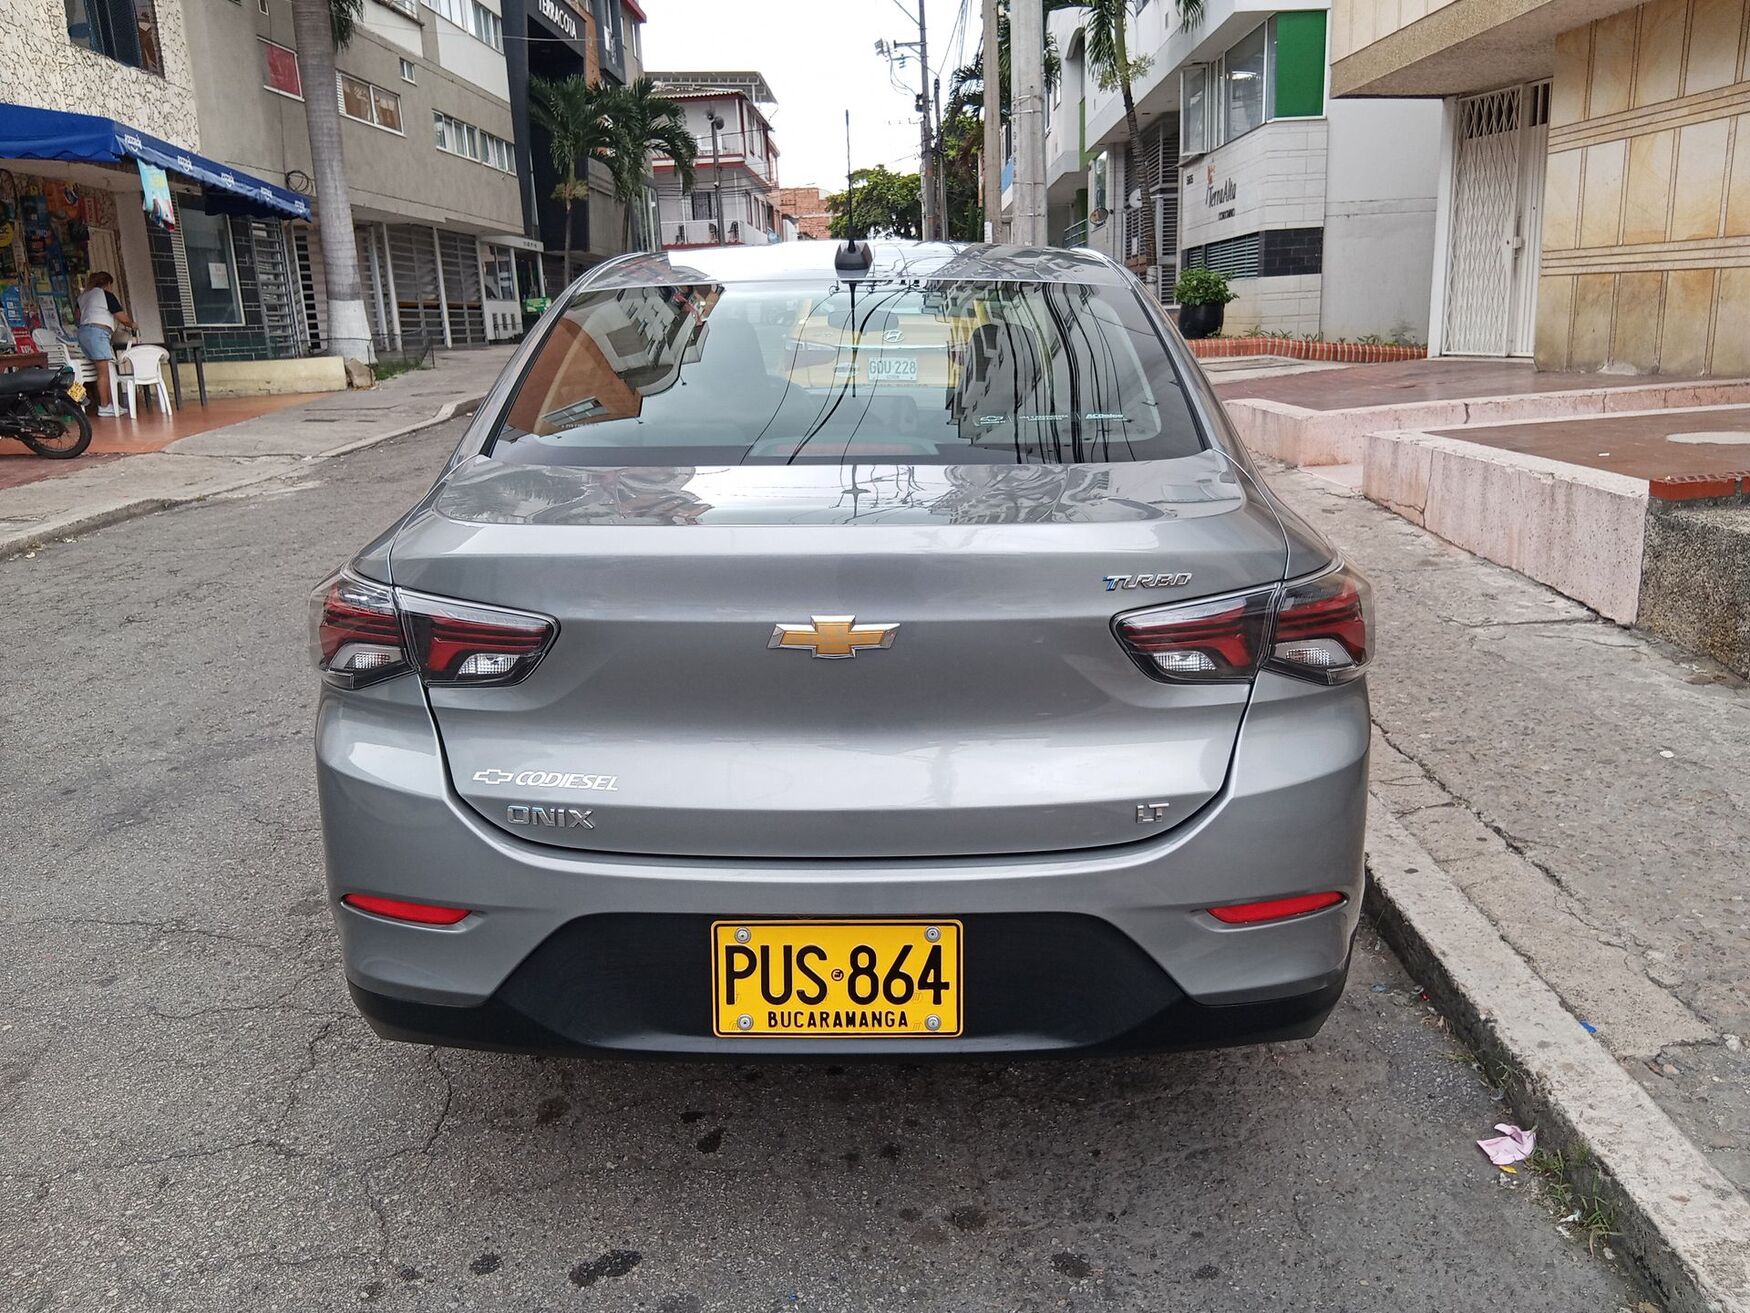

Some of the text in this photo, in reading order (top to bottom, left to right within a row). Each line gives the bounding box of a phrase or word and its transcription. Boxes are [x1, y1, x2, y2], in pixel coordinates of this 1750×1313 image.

[895, 361, 916, 375] 228
[1103, 572, 1192, 591] TURBO
[515, 771, 618, 791] CODIESEL
[507, 805, 595, 829] ONIX
[1136, 802, 1170, 824] LT
[725, 945, 950, 1005] PUS 864
[767, 1010, 908, 1029] BUCARAMANGA
